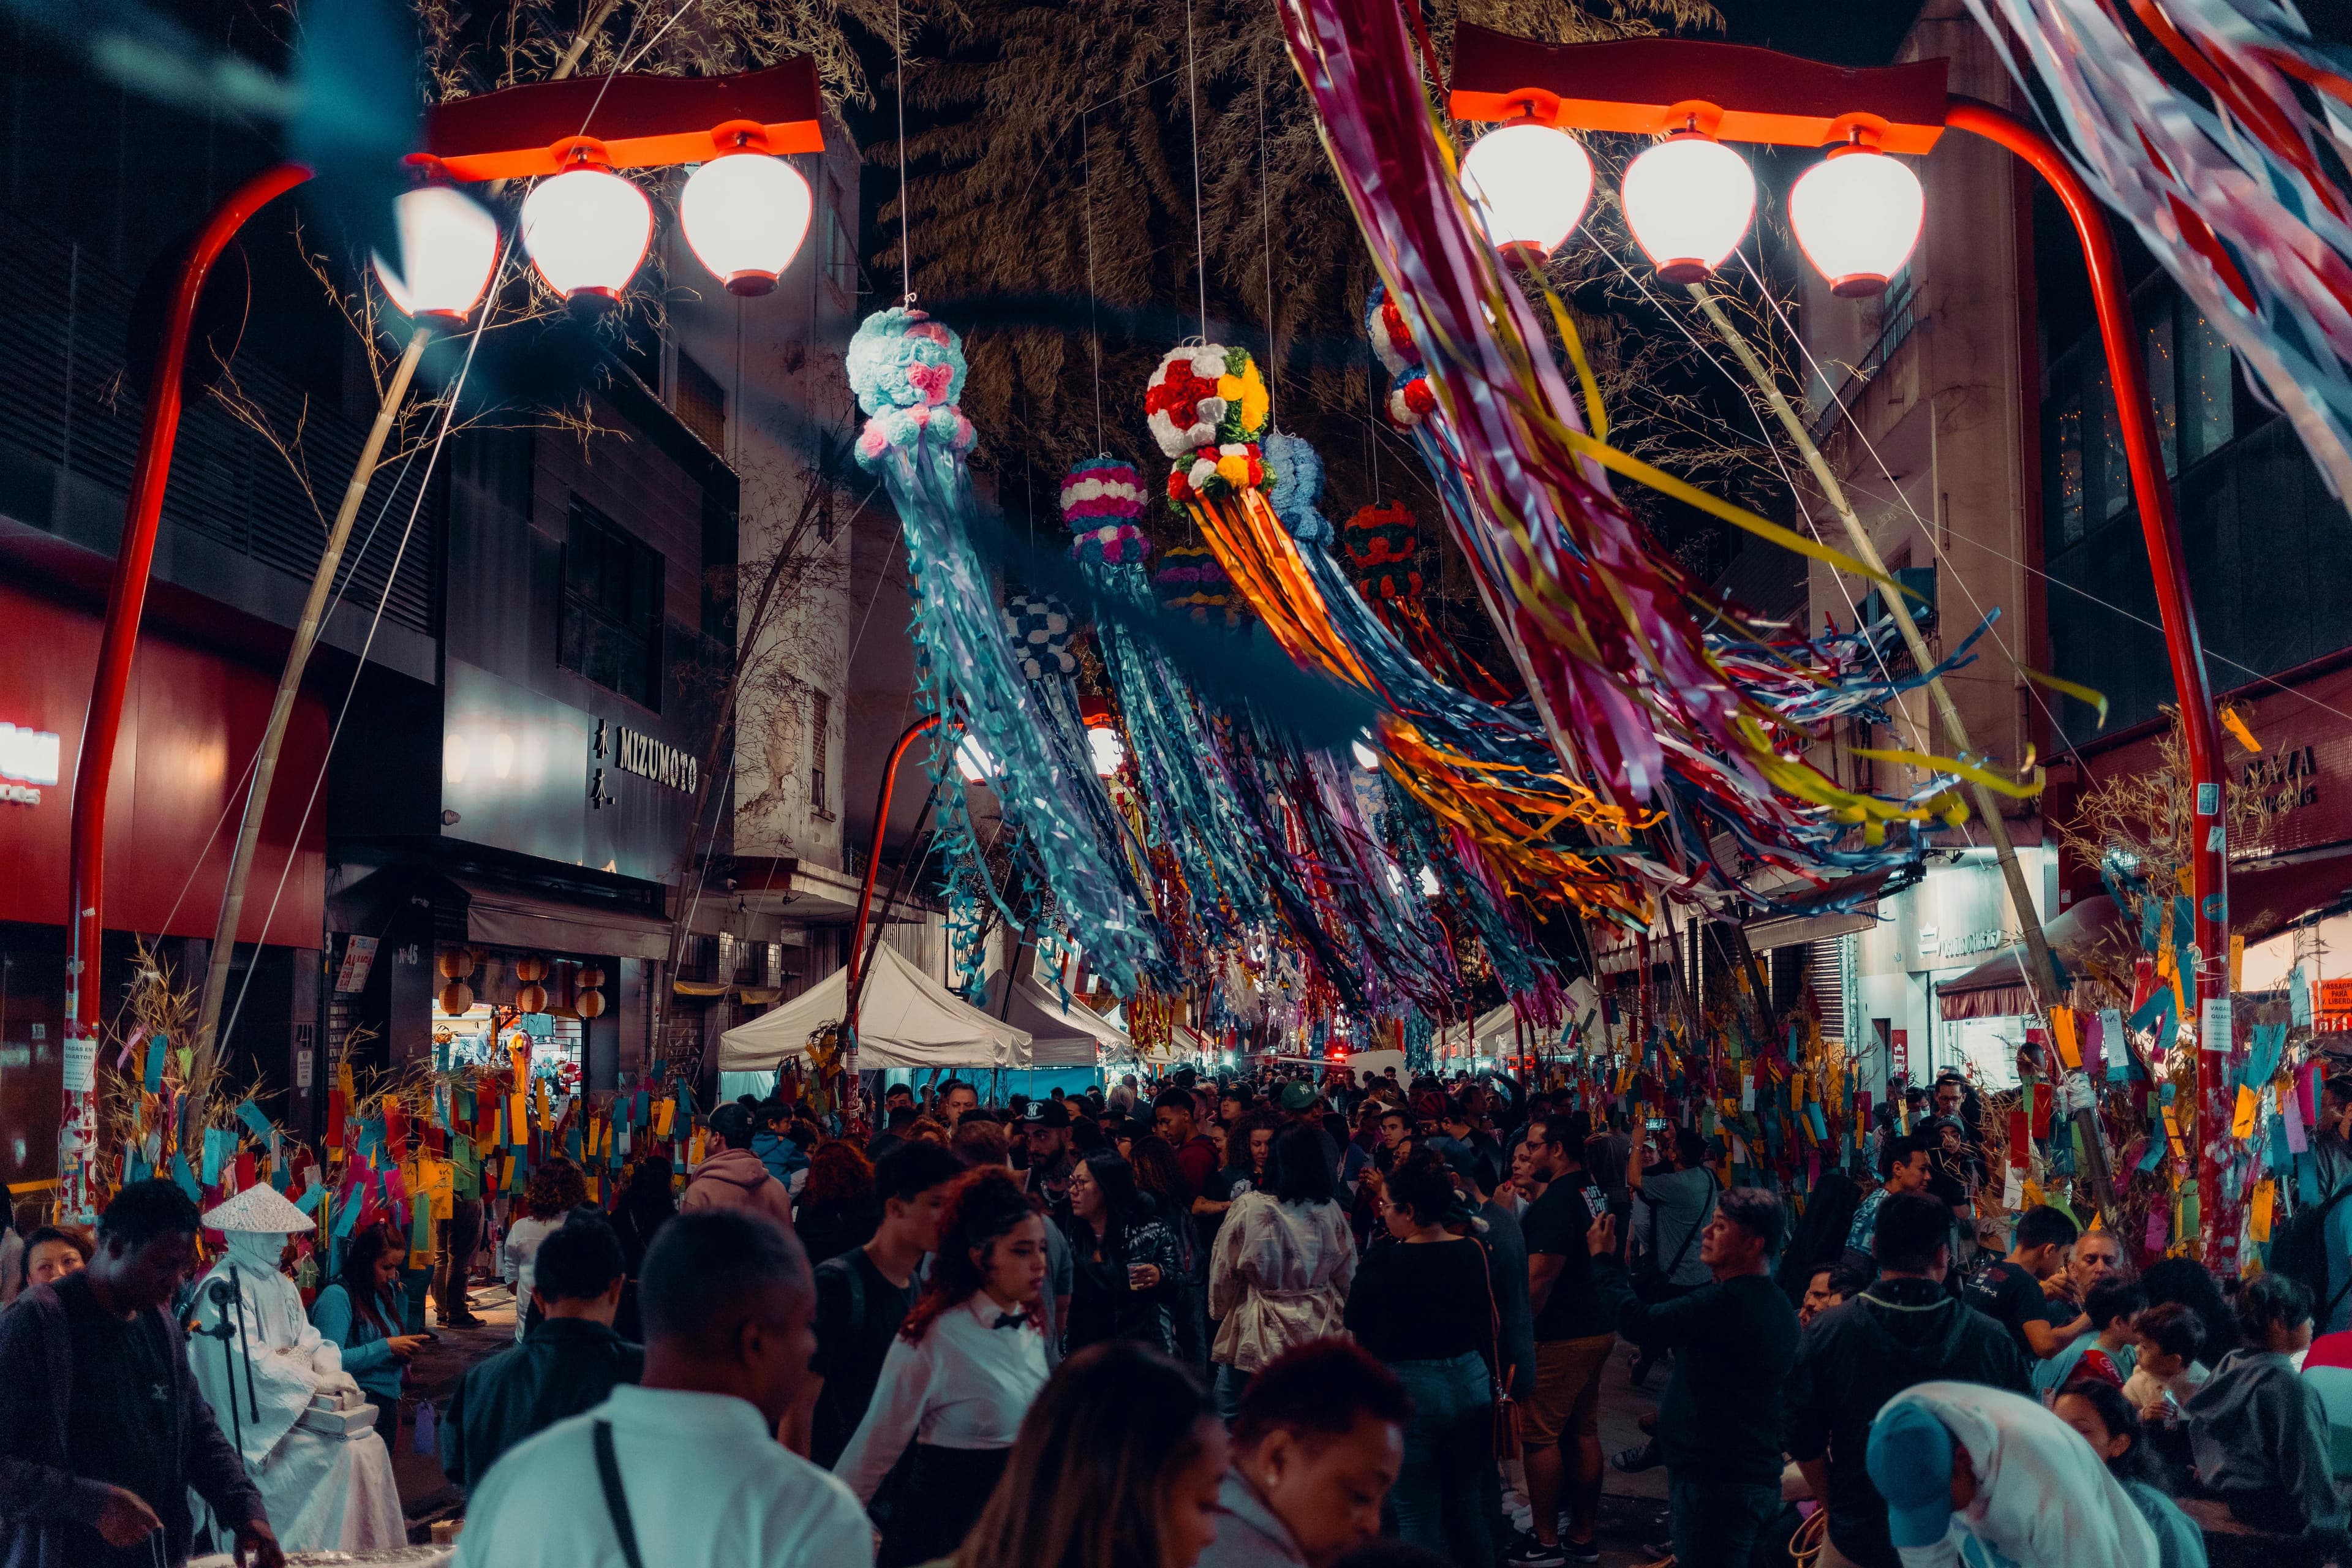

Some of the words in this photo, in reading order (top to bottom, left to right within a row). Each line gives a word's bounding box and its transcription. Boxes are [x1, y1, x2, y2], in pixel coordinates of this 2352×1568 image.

[619, 726, 698, 794] MIZUMOTO
[2242, 745, 2312, 787] PLAZA
[1586, 1185, 1601, 1198] OFF
